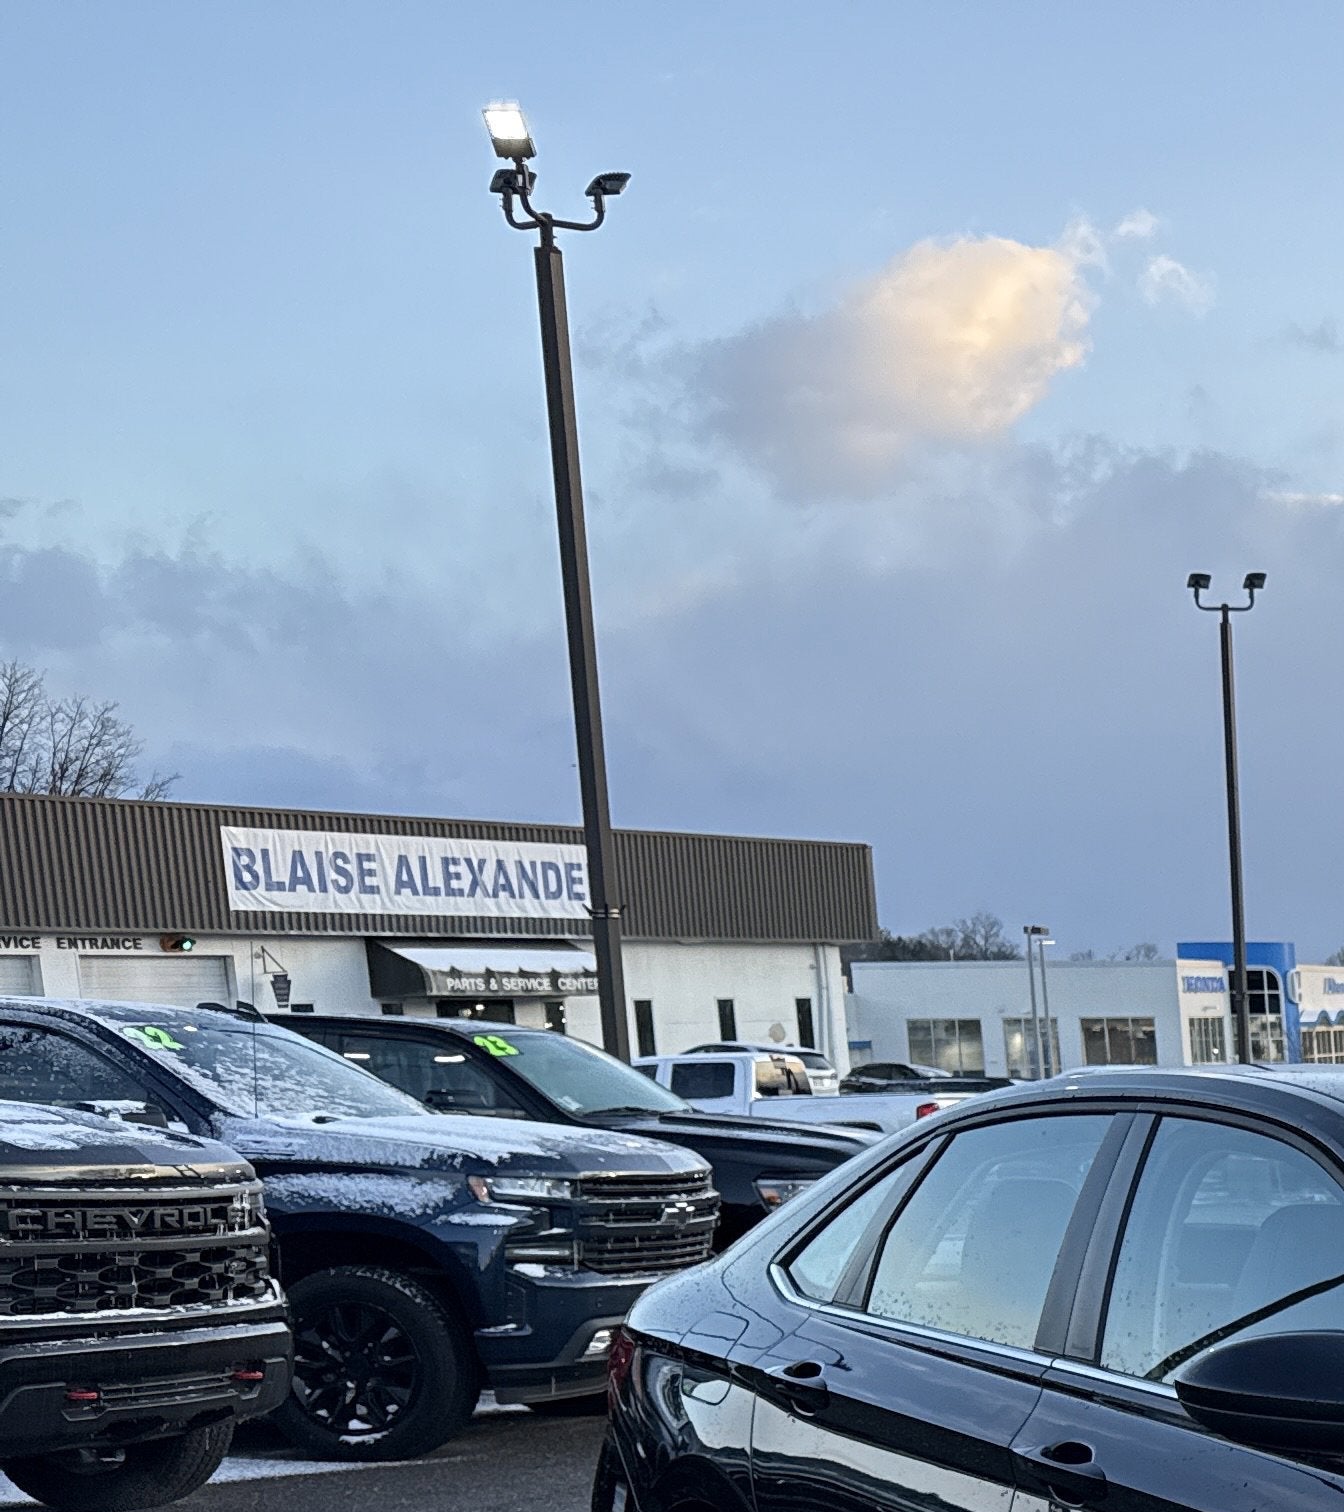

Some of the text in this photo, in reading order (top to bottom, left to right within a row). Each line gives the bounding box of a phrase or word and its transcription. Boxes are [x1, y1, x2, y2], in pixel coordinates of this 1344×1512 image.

[231, 847, 586, 900] BLAISE ALEXANDE
[0, 936, 143, 950] VICE ENTRANCE
[446, 977, 485, 991] PARTS
[490, 978, 498, 990] &
[502, 977, 552, 991] SERVICE
